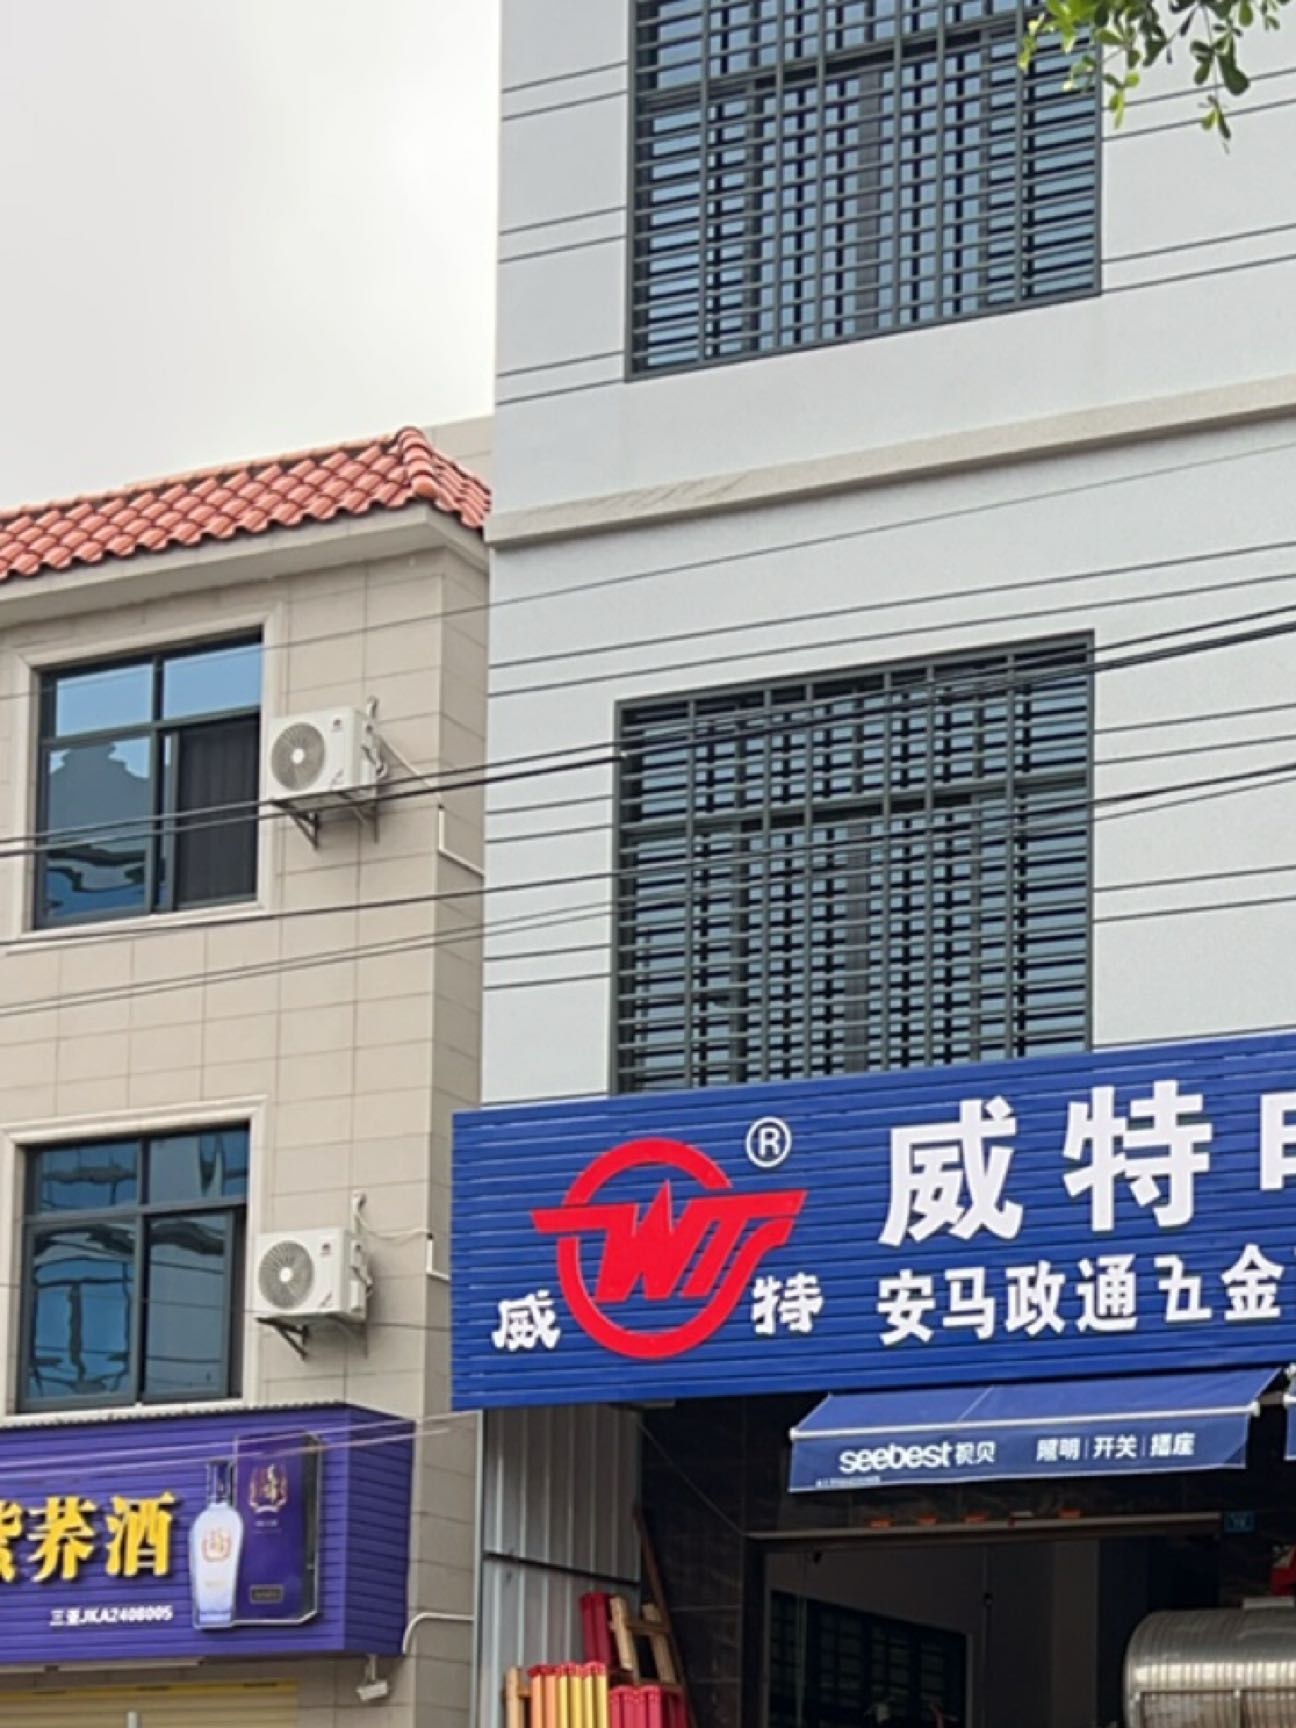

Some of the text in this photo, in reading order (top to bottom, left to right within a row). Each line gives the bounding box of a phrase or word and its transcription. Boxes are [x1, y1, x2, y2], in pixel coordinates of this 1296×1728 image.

[751, 1274, 822, 1337] 特
[839, 1440, 953, 1475] seebest
[1092, 1433, 1137, 1460] 开关
